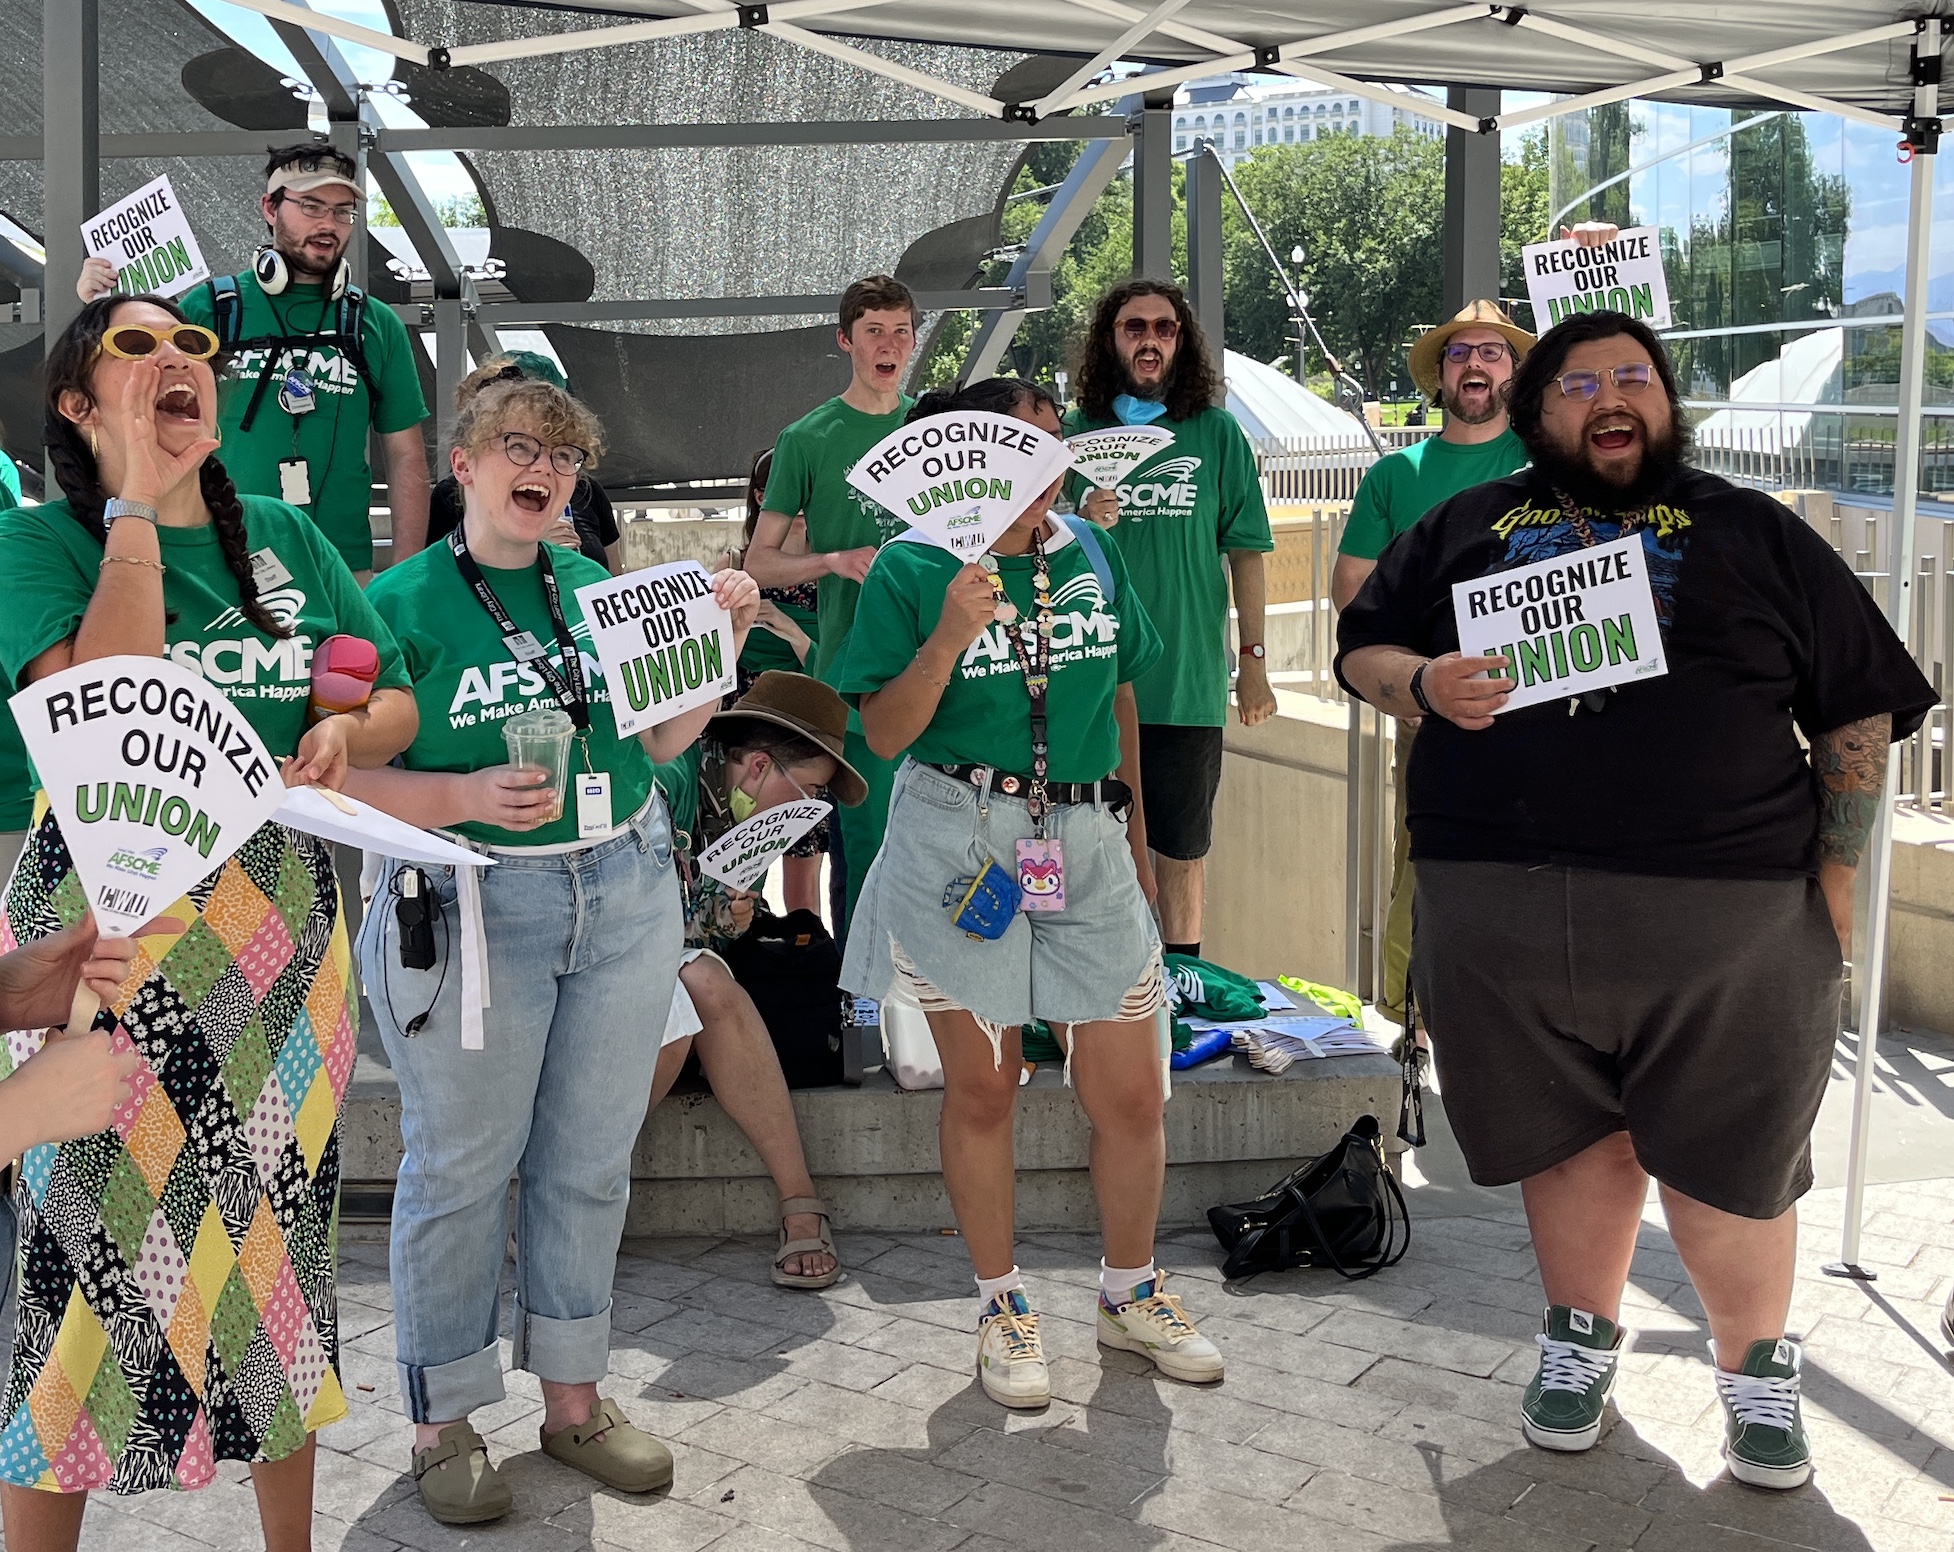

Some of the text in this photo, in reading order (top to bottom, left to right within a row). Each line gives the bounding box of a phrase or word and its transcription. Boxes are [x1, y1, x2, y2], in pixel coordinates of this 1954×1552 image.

[90, 188, 171, 252] RECOGNIZE
[122, 226, 158, 260] OUR
[1534, 236, 1650, 276] RECOGNIZE
[1574, 265, 1619, 291] OUR
[313, 378, 354, 395] Happen
[866, 422, 1039, 483] RECOGNIZE
[1073, 435, 1163, 447] COGNIZE
[1084, 443, 1127, 453] OUR
[922, 449, 987, 478] OUR
[907, 478, 1012, 516] UNION
[1079, 482, 1198, 508] SCME
[1118, 506, 1193, 518] America Happen
[946, 514, 982, 527] AFSCME
[591, 570, 714, 629] RECOGNIZE
[1468, 550, 1632, 619] RECOGNIZE
[641, 607, 691, 649] OUR
[1521, 595, 1586, 635] OUR
[163, 635, 313, 685] SCME
[620, 629, 723, 712] UNION
[961, 666, 986, 680] We
[990, 661, 1021, 675] Mak
[1085, 643, 1118, 659] Happe
[1484, 613, 1639, 693] UNION
[223, 684, 310, 703] rica Happe
[449, 650, 605, 714] AFSM
[450, 714, 476, 729] We
[481, 701, 524, 722] Make
[46, 677, 270, 798] RECOGNIZE
[121, 729, 207, 788] OUR
[76, 782, 221, 858] UNION
[706, 806, 822, 863] RECOGNIZE
[740, 824, 785, 850] OUR
[107, 851, 162, 875] AFSCME
[722, 836, 792, 874] UNION
